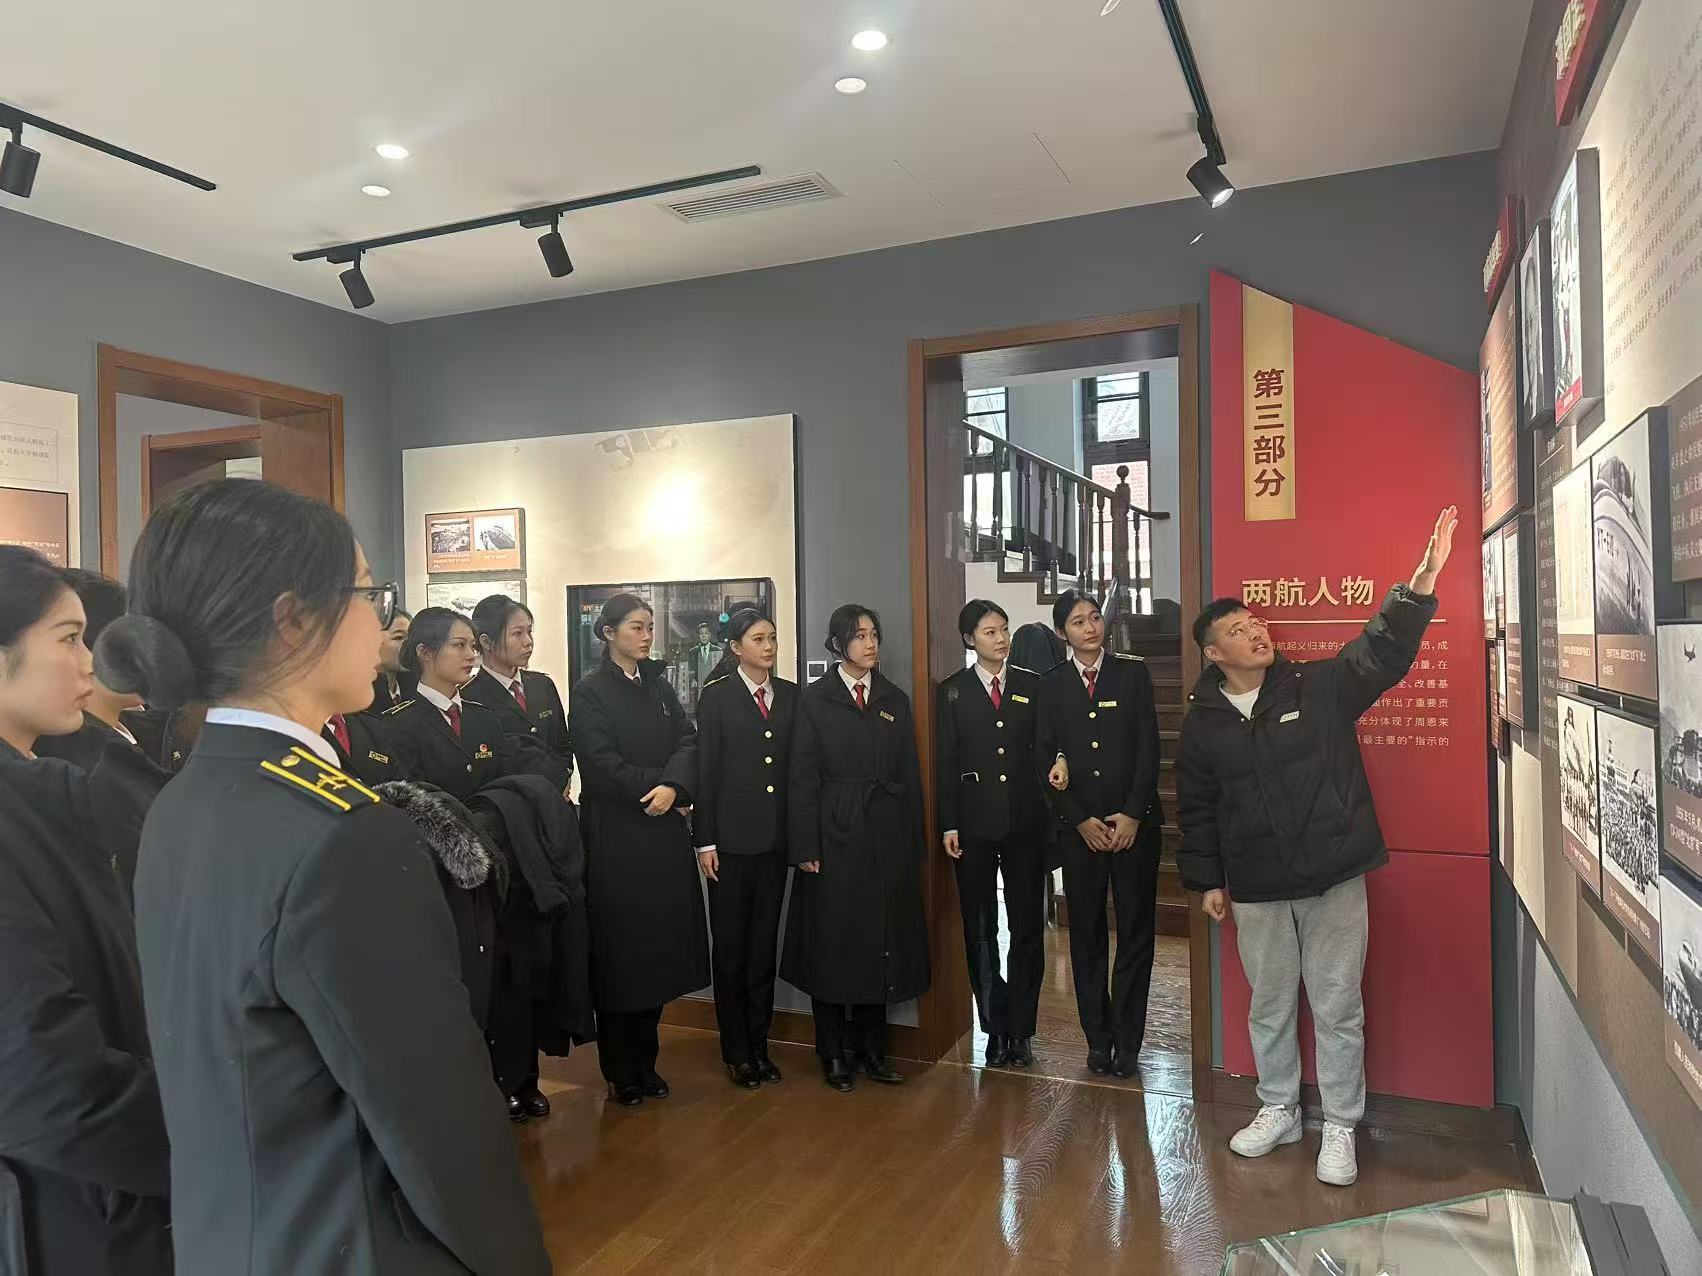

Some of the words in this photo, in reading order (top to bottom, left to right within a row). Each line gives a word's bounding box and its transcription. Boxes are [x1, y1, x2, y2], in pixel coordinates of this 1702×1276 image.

[1253, 368, 1286, 497] 第三部分
[1242, 576, 1374, 607] 两航人物
[1358, 716, 1449, 727] 充分体现了周恩来
[1357, 735, 1449, 746] 最主要的”指示的
